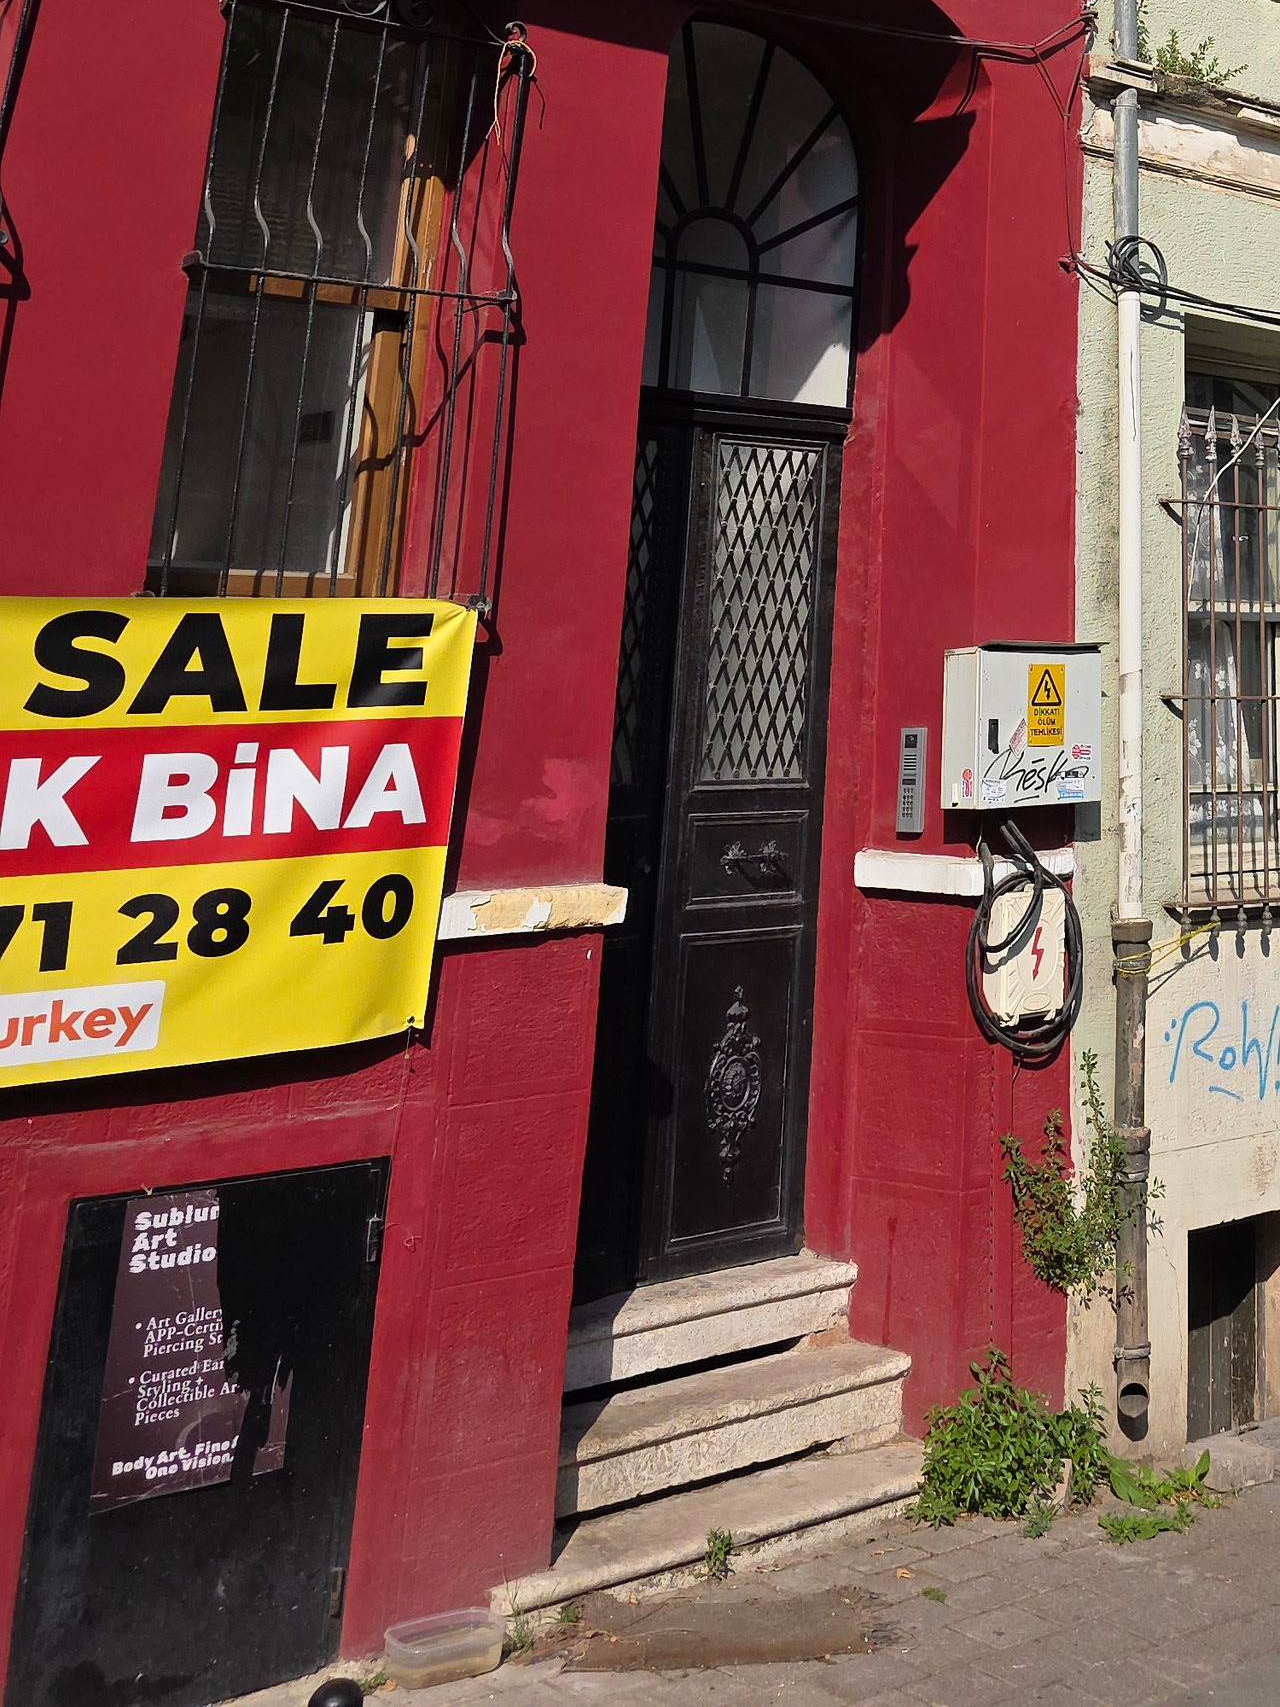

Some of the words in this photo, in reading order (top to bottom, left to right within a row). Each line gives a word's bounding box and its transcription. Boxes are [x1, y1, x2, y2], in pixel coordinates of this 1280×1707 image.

[23, 610, 435, 719] SALE
[116, 887, 252, 965] 28
[290, 874, 414, 945] 40
[131, 1228, 177, 1253] Art
[129, 1244, 217, 1274] Studio
[146, 1317, 170, 1331] Art
[143, 1337, 204, 1358] Piercing
[140, 1361, 198, 1385] Curated
[136, 1385, 215, 1412] Collectible
[138, 1379, 191, 1399] Styling
[134, 1408, 180, 1426] Pieces
[112, 1455, 155, 1476] Body
[146, 1463, 179, 1481] One
